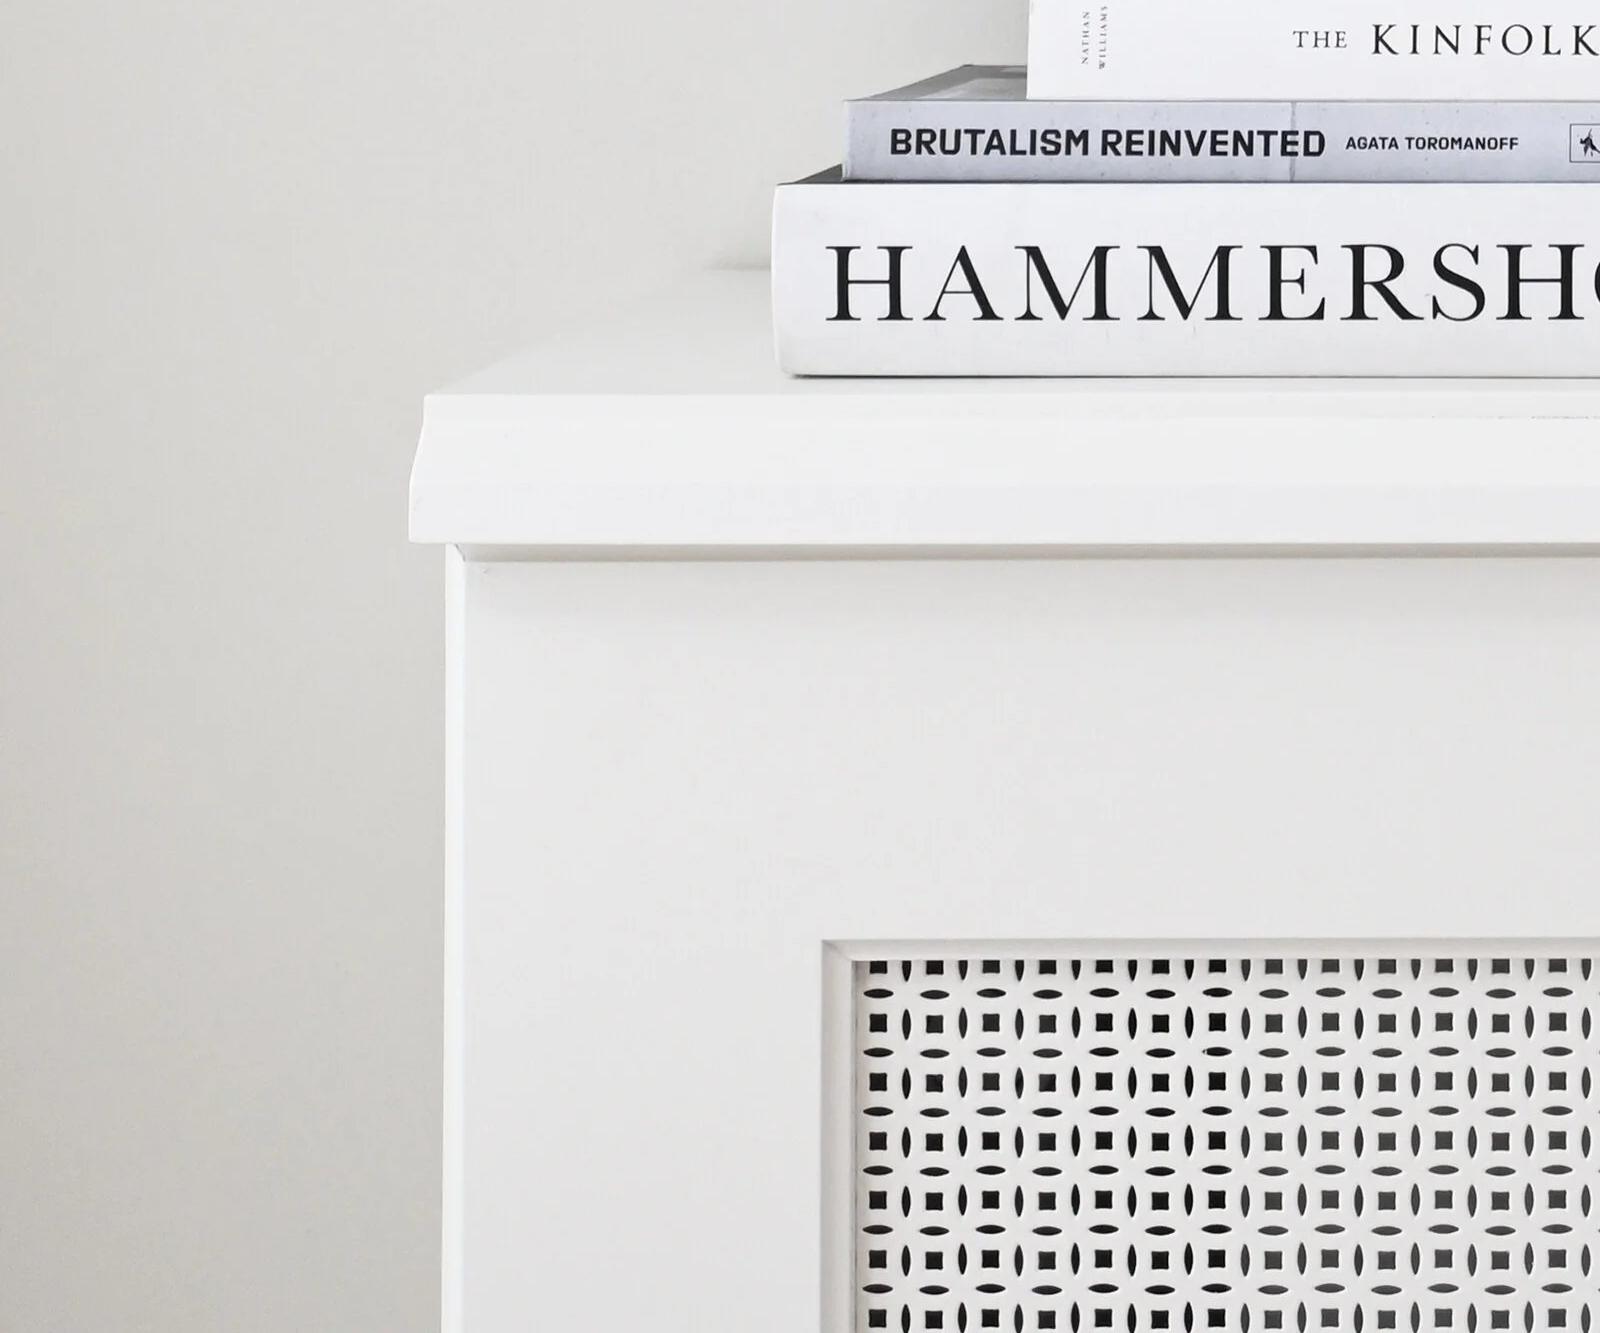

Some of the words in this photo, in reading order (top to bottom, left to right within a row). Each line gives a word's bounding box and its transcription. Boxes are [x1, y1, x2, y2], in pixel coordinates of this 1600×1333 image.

[1081, 11, 1090, 65] NATHAN
[1098, 5, 1108, 70] WILLIAMS
[1292, 30, 1348, 49] THE
[1371, 23, 1600, 57] KINFOLK
[890, 128, 1090, 157] BRUTALISM
[1100, 129, 1326, 158] REINVENTED
[1345, 136, 1399, 150] AGATA
[1404, 136, 1519, 151] TOROMANOFF
